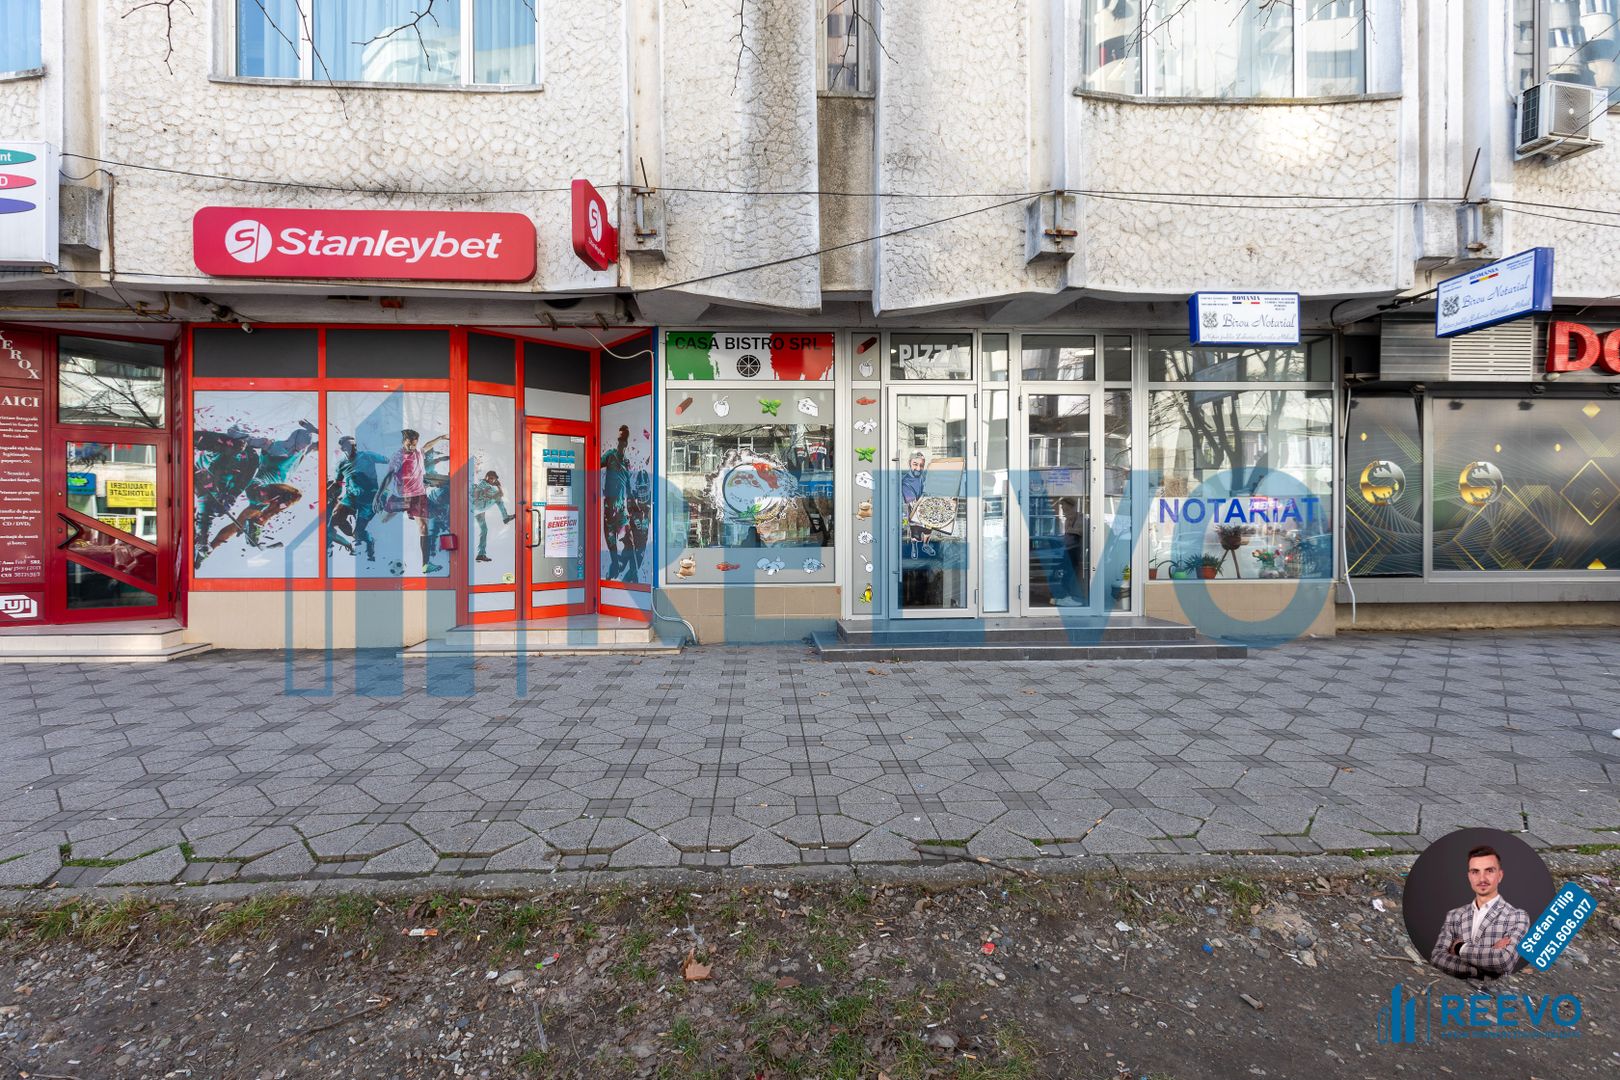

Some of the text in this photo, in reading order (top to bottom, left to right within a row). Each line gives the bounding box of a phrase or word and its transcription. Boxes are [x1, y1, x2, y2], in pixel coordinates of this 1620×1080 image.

[276, 226, 503, 263] Stanleybet
[1487, 274, 1531, 301] Notarial
[1222, 312, 1297, 328] Birou Notarial
[674, 336, 822, 351] CASA BISTRO SRL
[899, 344, 962, 368] PIZZA
[1, 395, 40, 408] AICI
[1159, 498, 1319, 524] NOTARIAT
